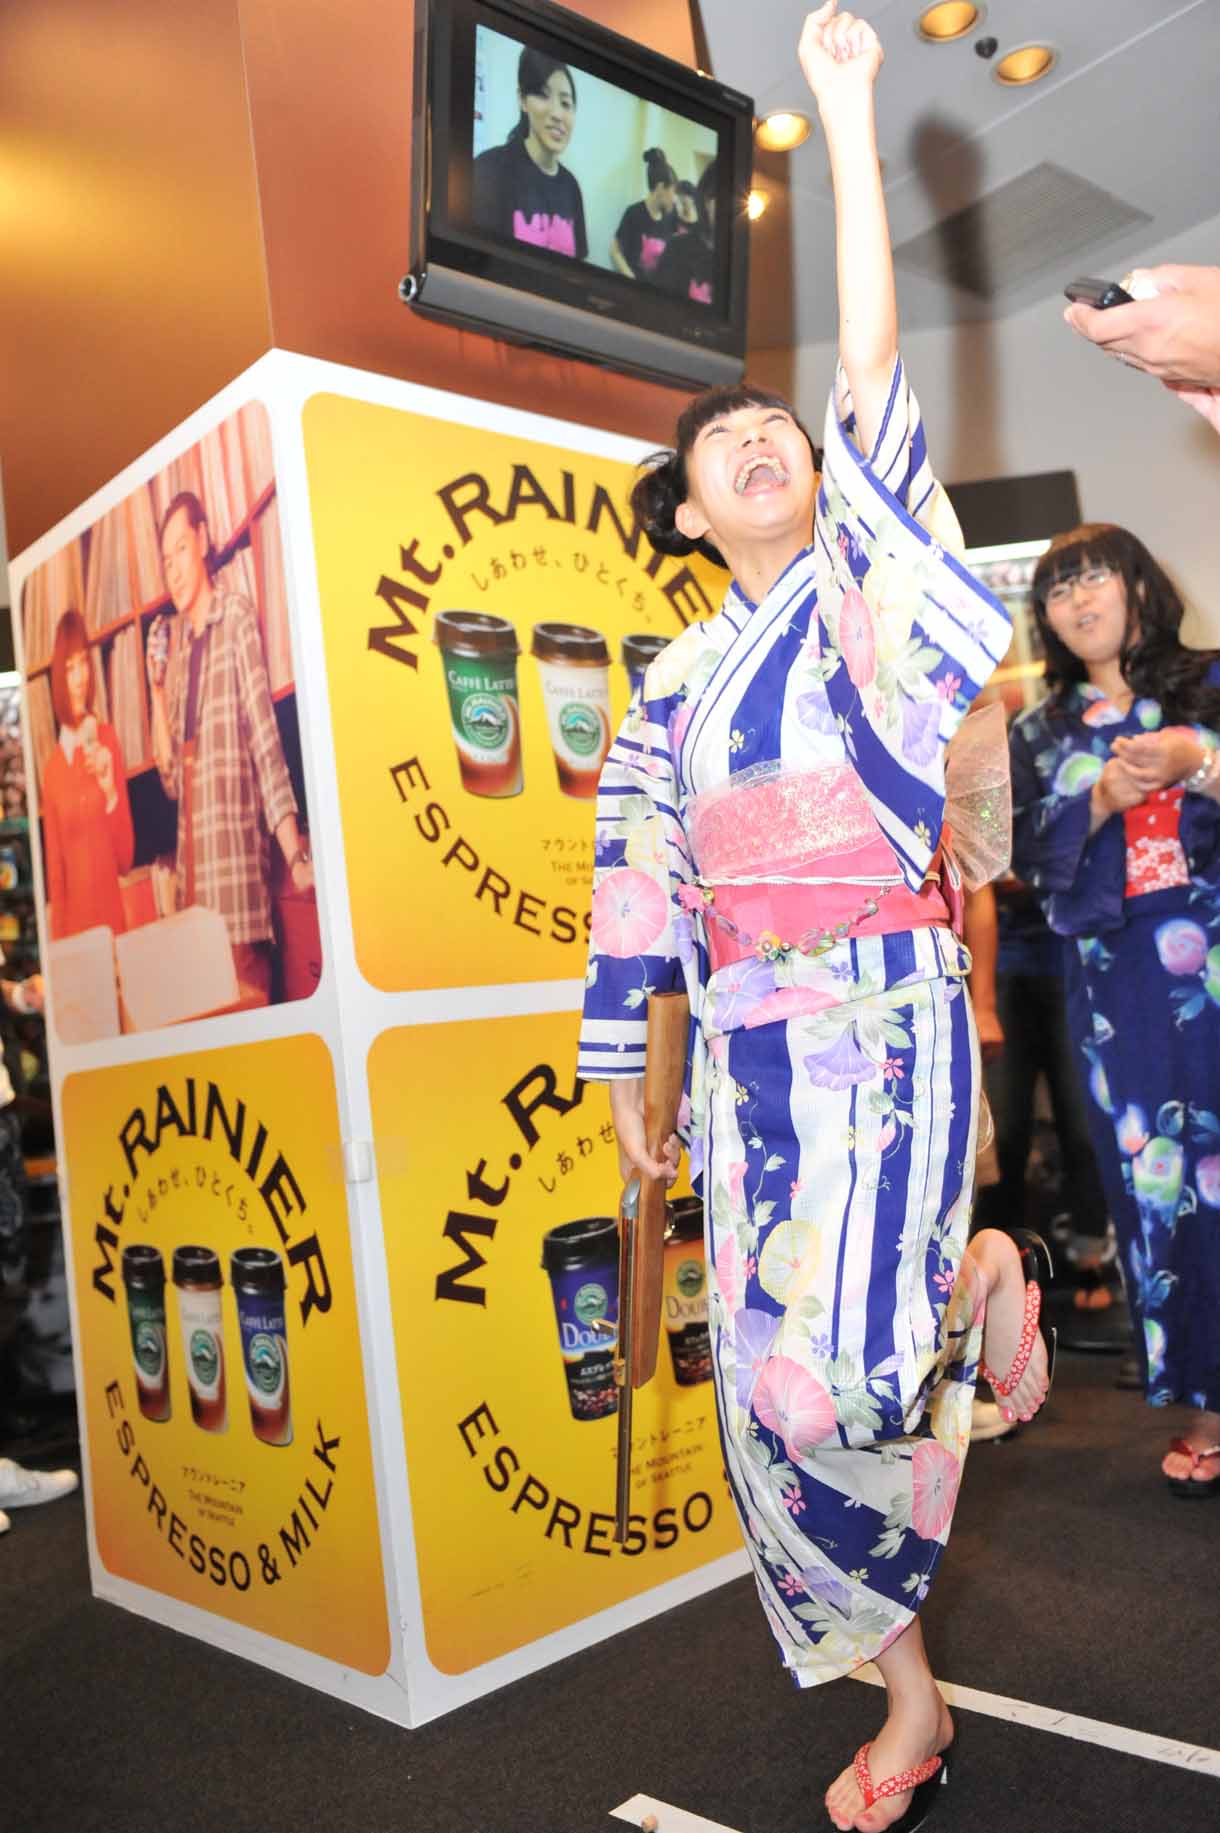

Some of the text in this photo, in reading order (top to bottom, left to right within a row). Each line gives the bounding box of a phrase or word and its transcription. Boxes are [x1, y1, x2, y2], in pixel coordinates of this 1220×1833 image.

[540, 837, 595, 852] マウント
[105, 1380, 341, 1591] ESPRESSO & MILK
[457, 1401, 713, 1557] ESPRESSO
